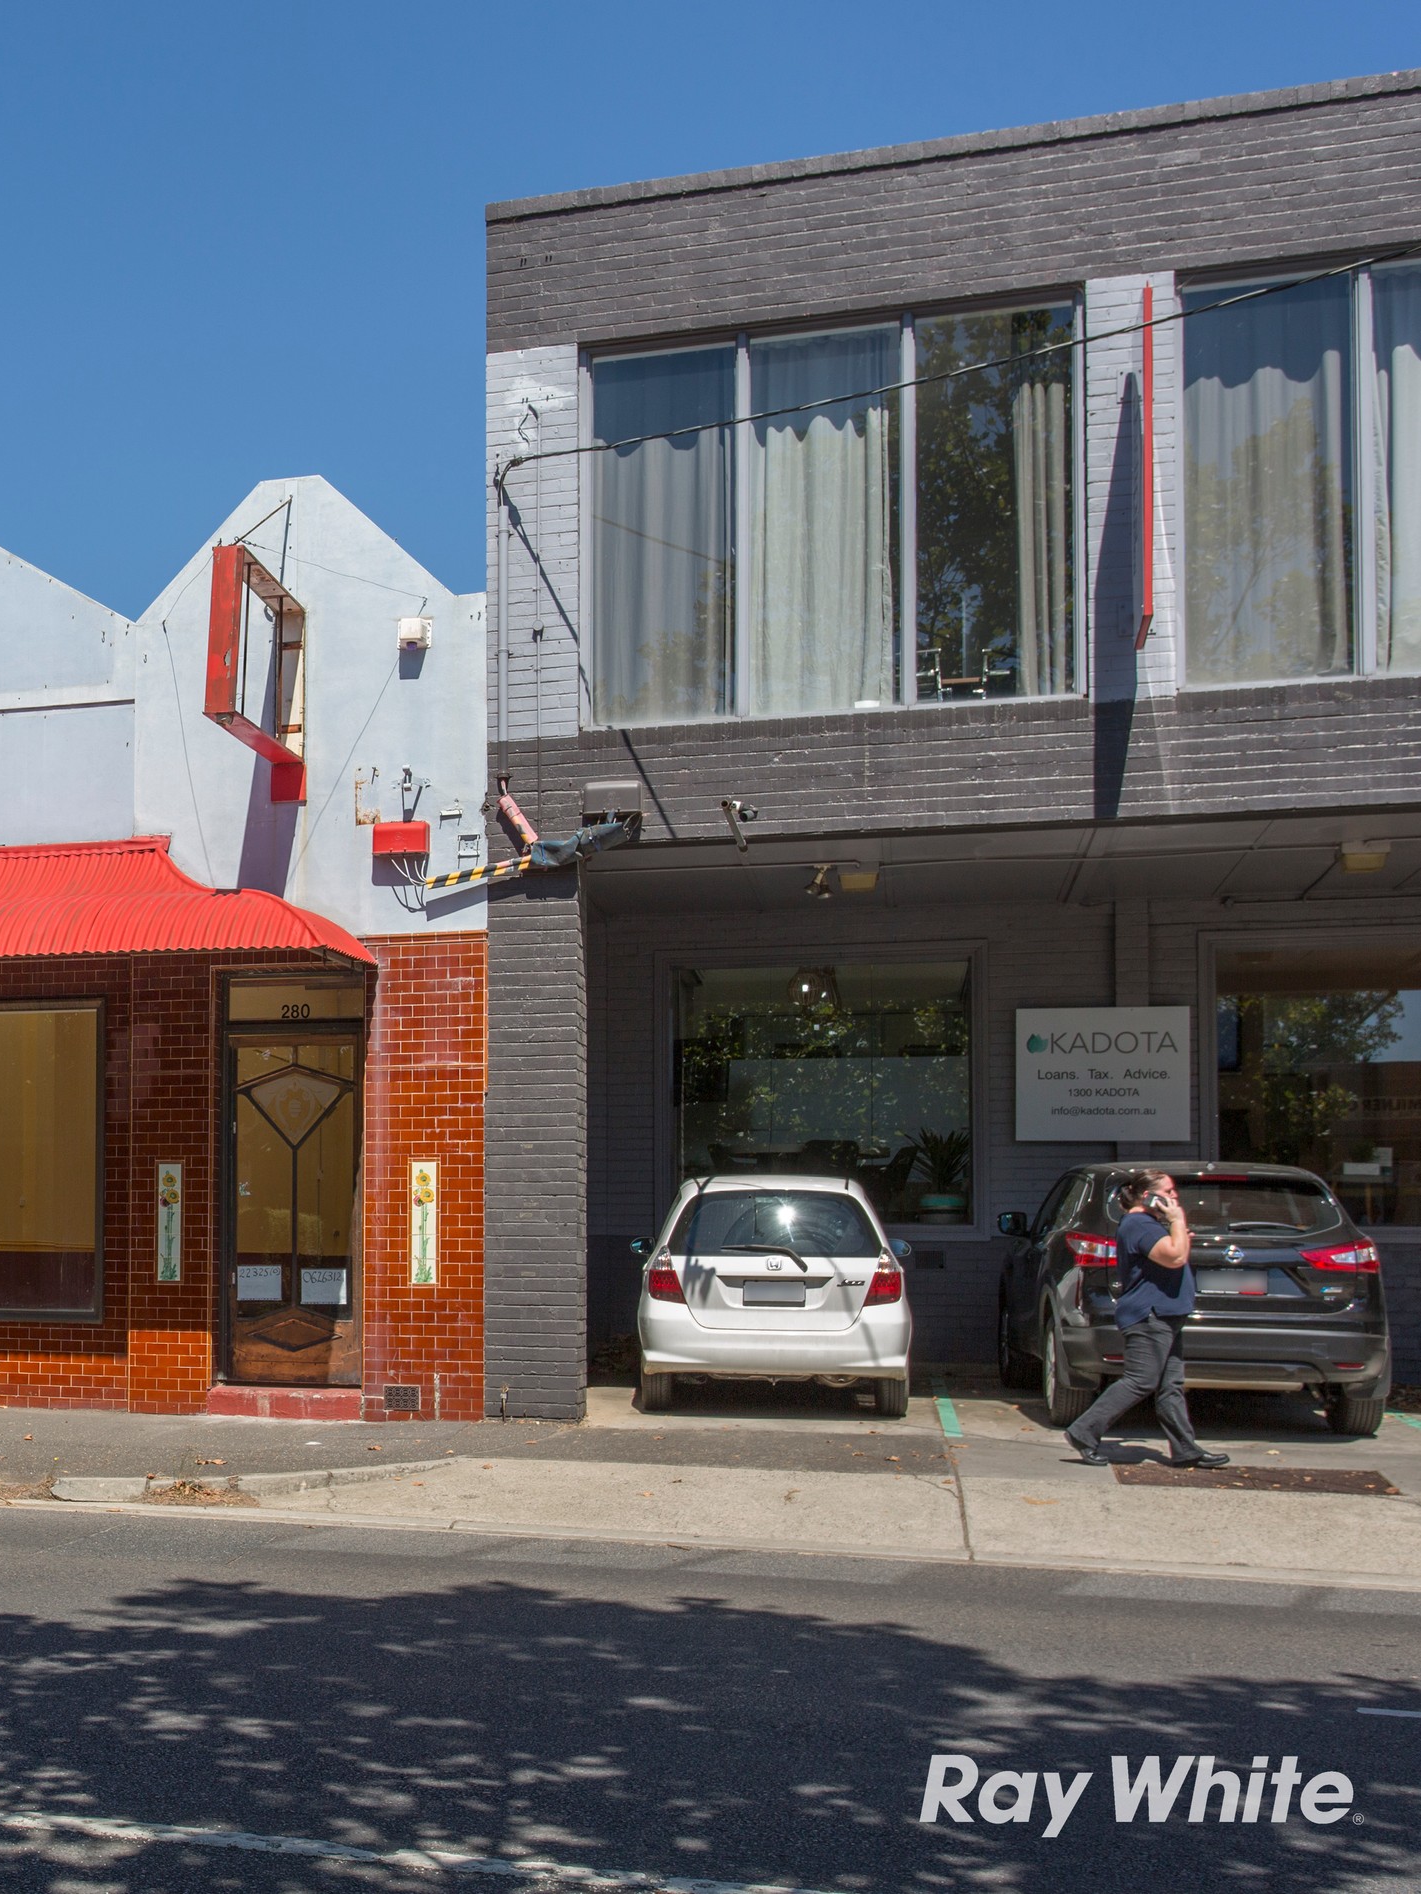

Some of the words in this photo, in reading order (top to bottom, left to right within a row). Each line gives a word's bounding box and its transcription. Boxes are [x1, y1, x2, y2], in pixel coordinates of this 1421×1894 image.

[280, 1003, 311, 1019] 280
[1050, 1031, 1178, 1054] KADOTA
[1037, 1068, 1079, 1080] Loans.
[1088, 1068, 1113, 1080] Tax.
[1123, 1068, 1170, 1080] Advice.
[1068, 1088, 1092, 1097] 1300
[1095, 1088, 1140, 1097] KADOTA
[1051, 1106, 1156, 1116] info@kadota.com.au
